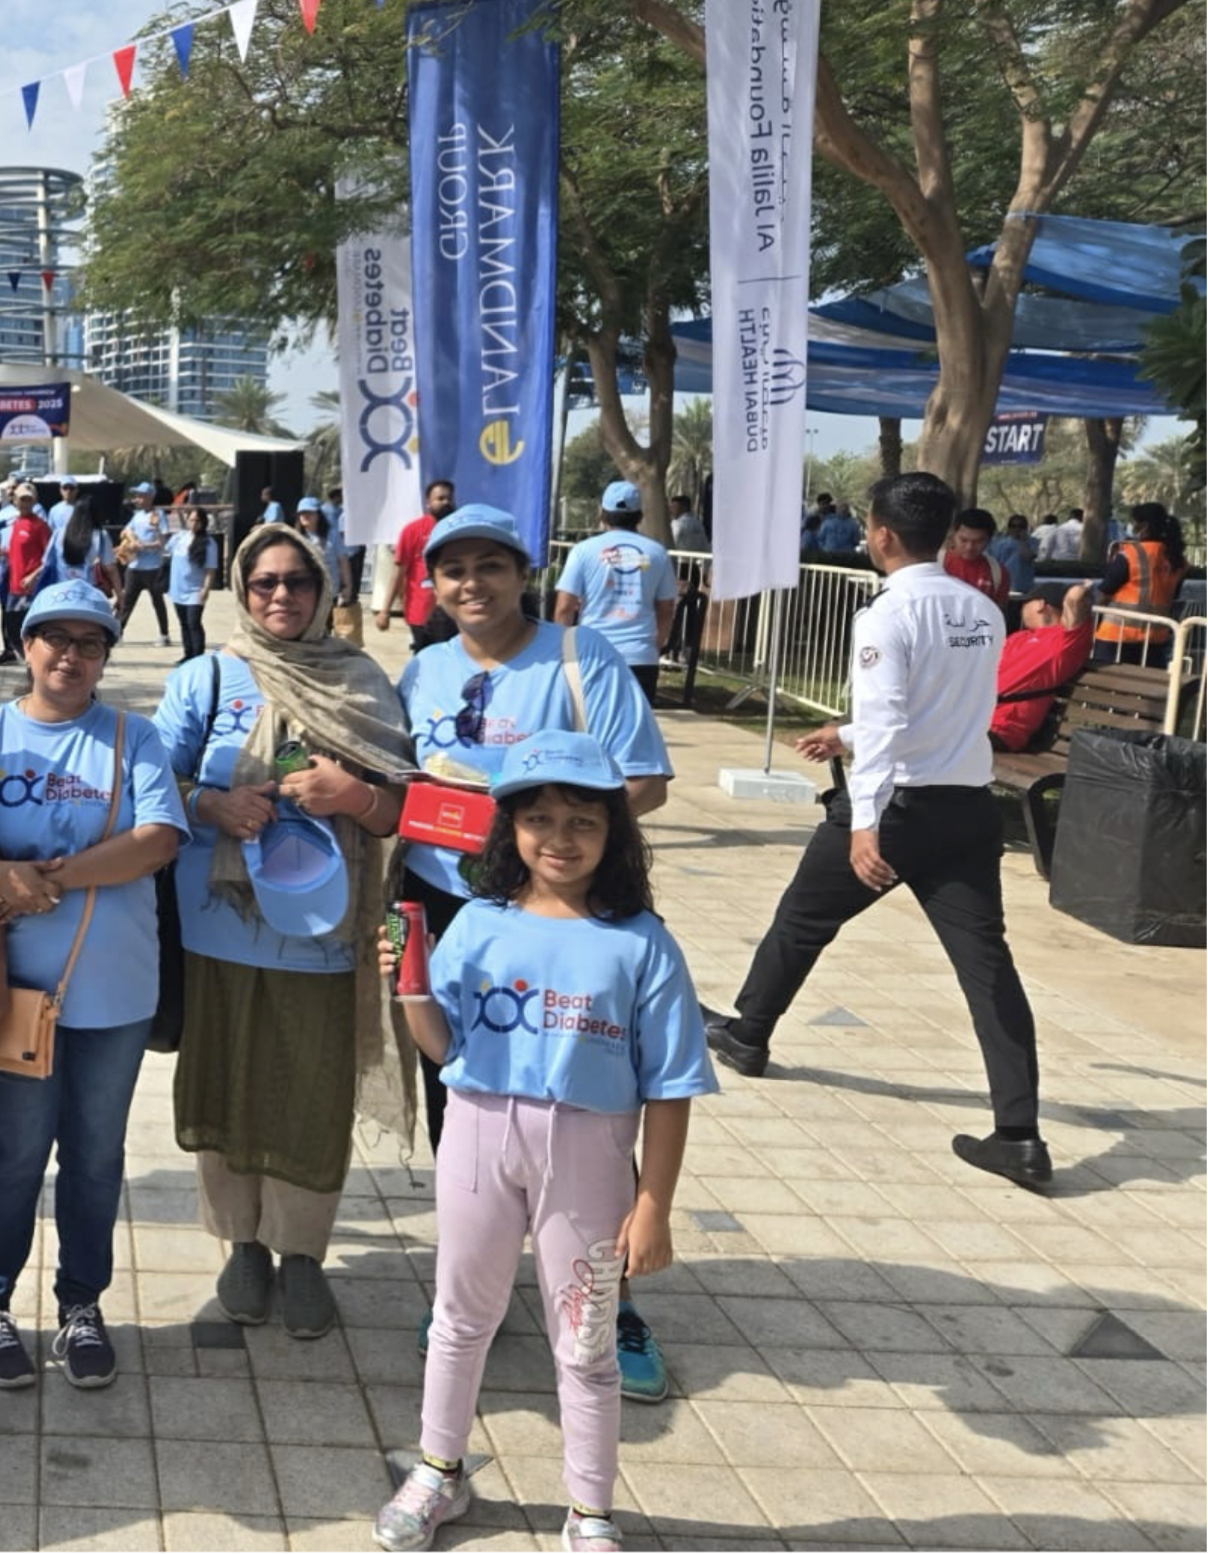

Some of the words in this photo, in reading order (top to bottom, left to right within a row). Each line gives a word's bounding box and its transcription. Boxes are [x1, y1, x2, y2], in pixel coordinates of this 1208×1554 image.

[37, 398, 63, 410] 2025
[984, 423, 1044, 454] START
[948, 635, 994, 648] SECURITY
[47, 772, 81, 787] Beat
[45, 788, 113, 801] Diabete
[543, 988, 592, 1011] Beat
[543, 1011, 627, 1041] Diabetes
